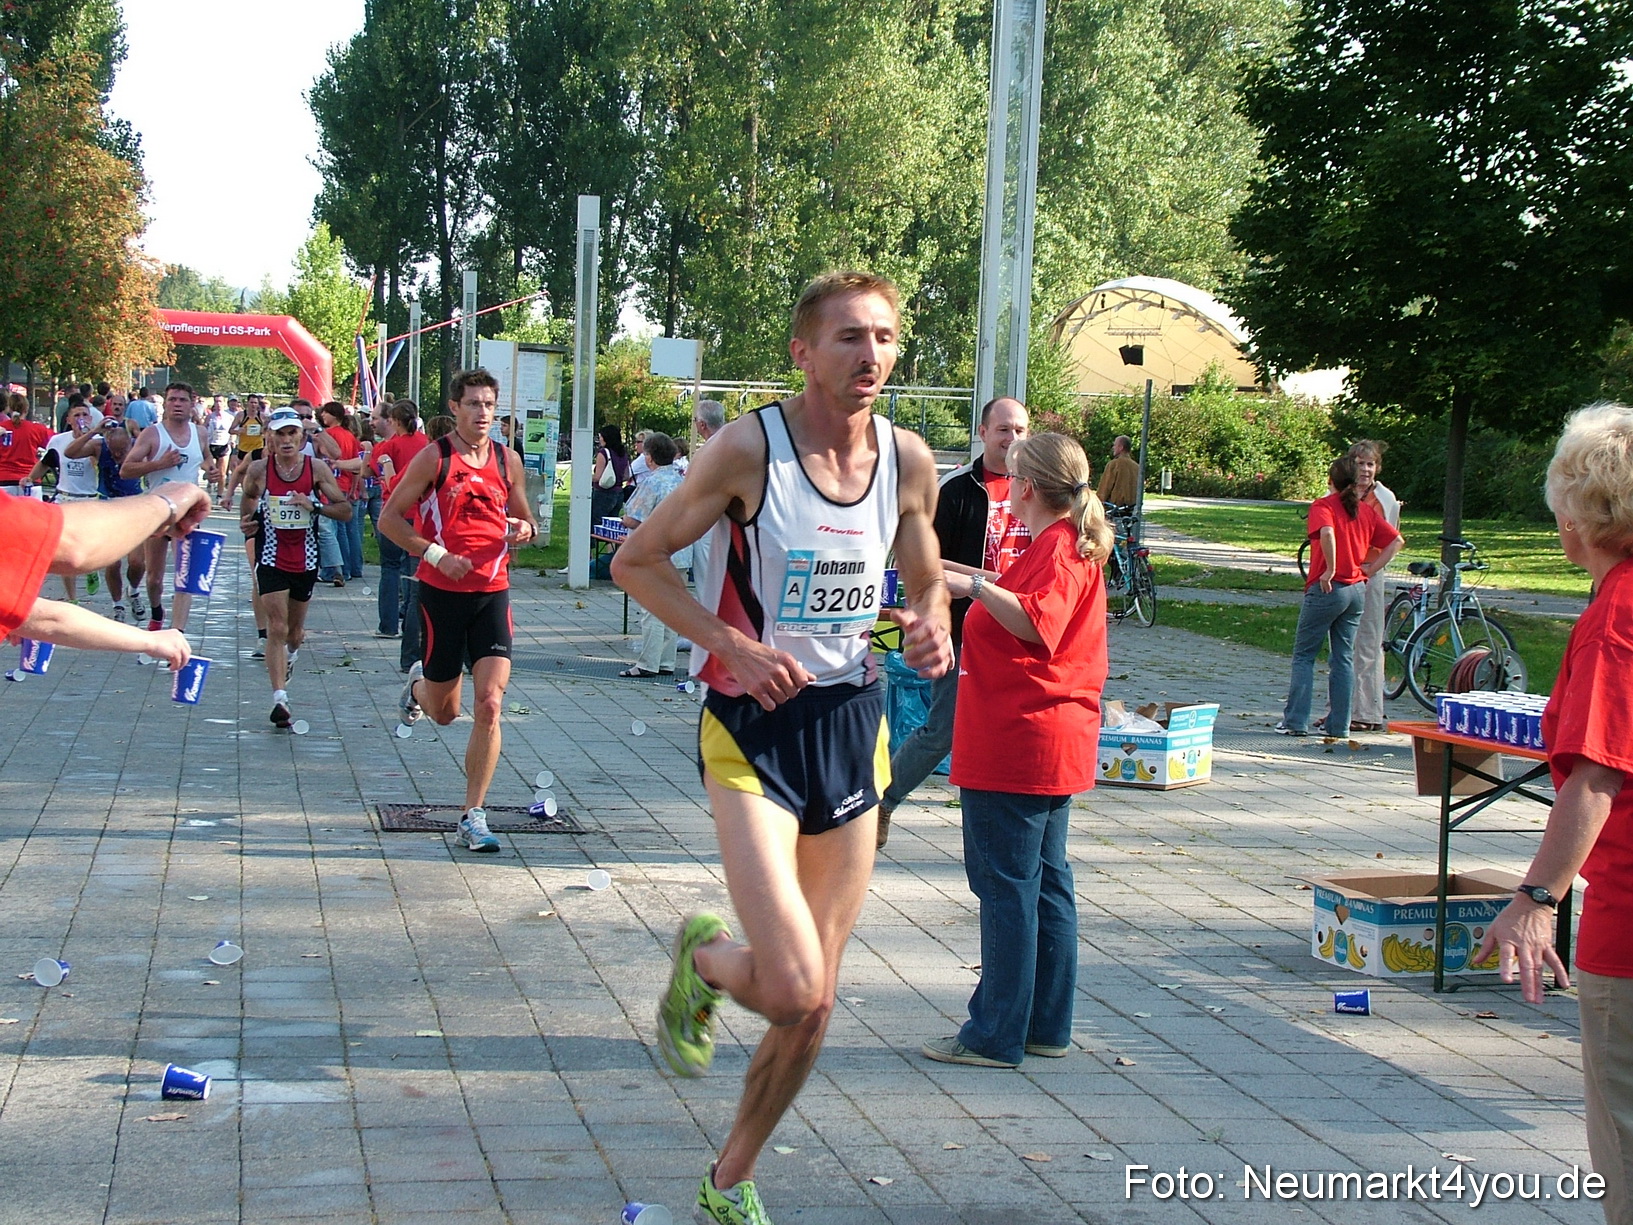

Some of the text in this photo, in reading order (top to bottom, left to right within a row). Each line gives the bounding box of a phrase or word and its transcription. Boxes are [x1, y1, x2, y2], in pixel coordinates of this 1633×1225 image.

[158, 321, 271, 336] Verpflegung LGS-Park
[280, 510, 301, 520] 978
[814, 560, 865, 575] Johann
[787, 583, 800, 596] A
[810, 585, 875, 613] 3208
[1459, 904, 1505, 918] BANAN
